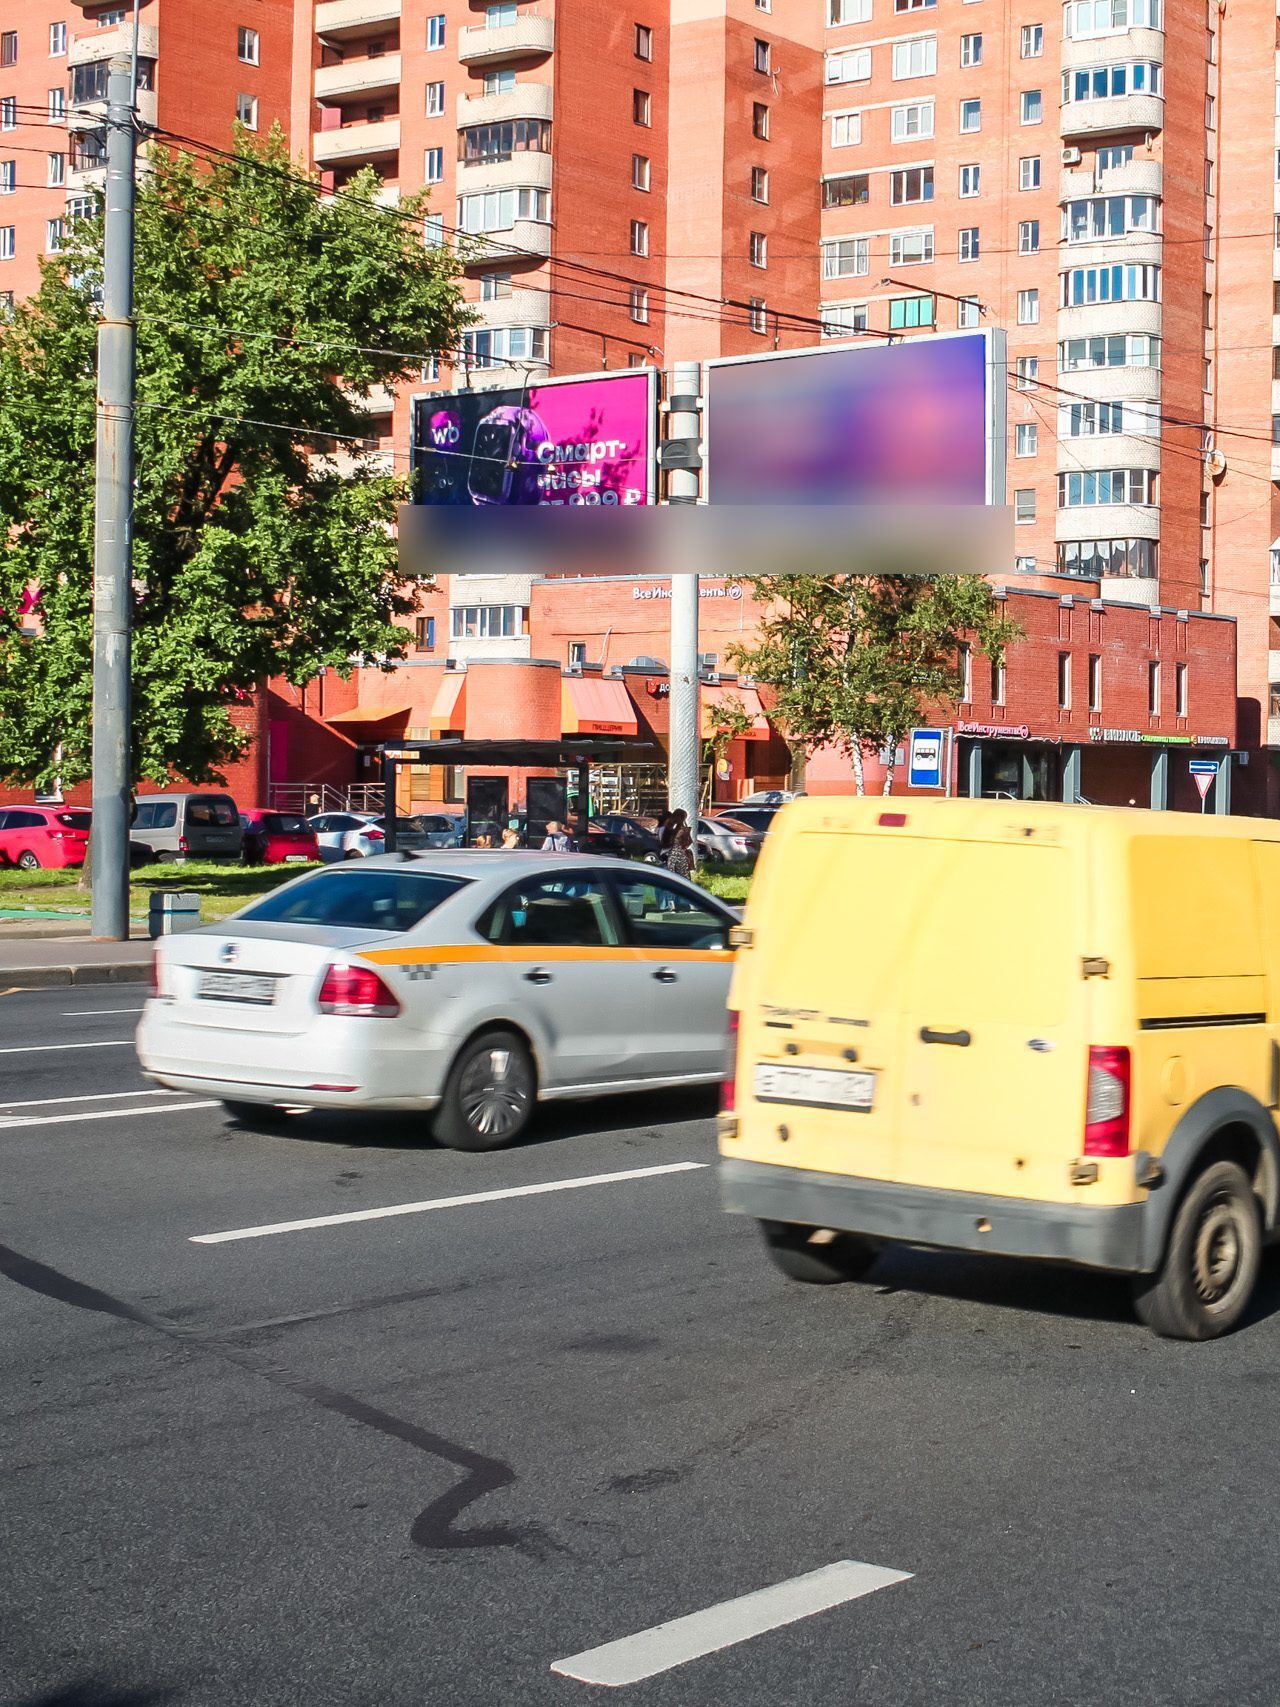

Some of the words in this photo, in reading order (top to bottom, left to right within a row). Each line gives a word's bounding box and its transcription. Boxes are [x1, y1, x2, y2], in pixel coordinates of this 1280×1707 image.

[431, 420, 459, 445] wb
[537, 440, 626, 464] Смарт-
[537, 469, 601, 490] часы
[633, 587, 729, 599] ВсеИнсенты
